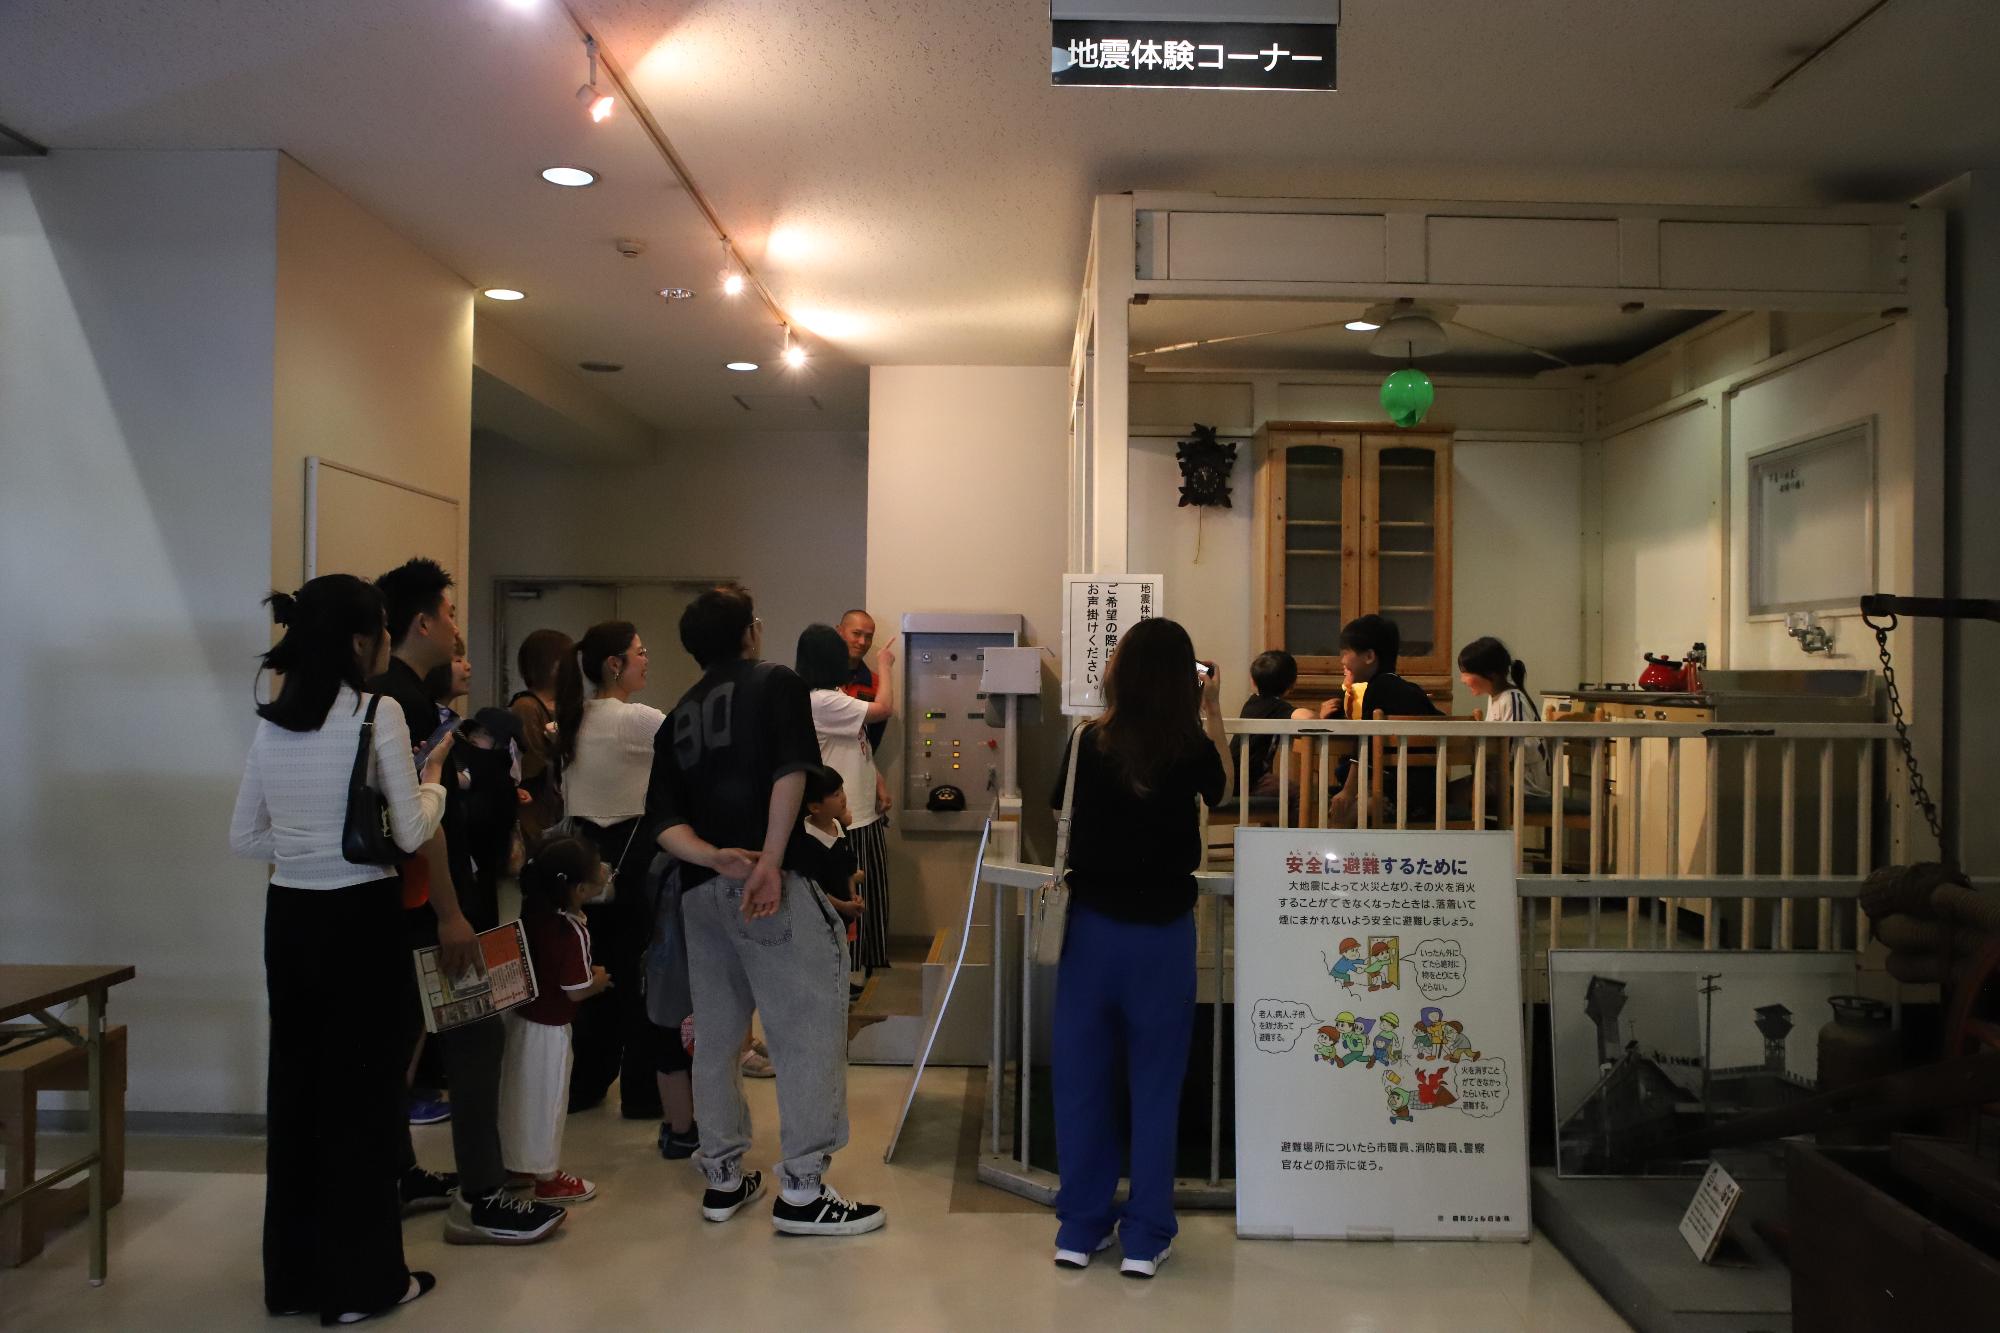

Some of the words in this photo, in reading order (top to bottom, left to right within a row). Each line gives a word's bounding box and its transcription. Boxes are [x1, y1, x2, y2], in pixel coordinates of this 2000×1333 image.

[1068, 38, 1323, 71] 地震体験コーナー
[1086, 583, 1099, 690] お声掛けください。
[673, 681, 735, 770] 90
[1286, 856, 1468, 875] 安全に避難するために
[1281, 1159, 1383, 1171] 官などの指示に従う。
